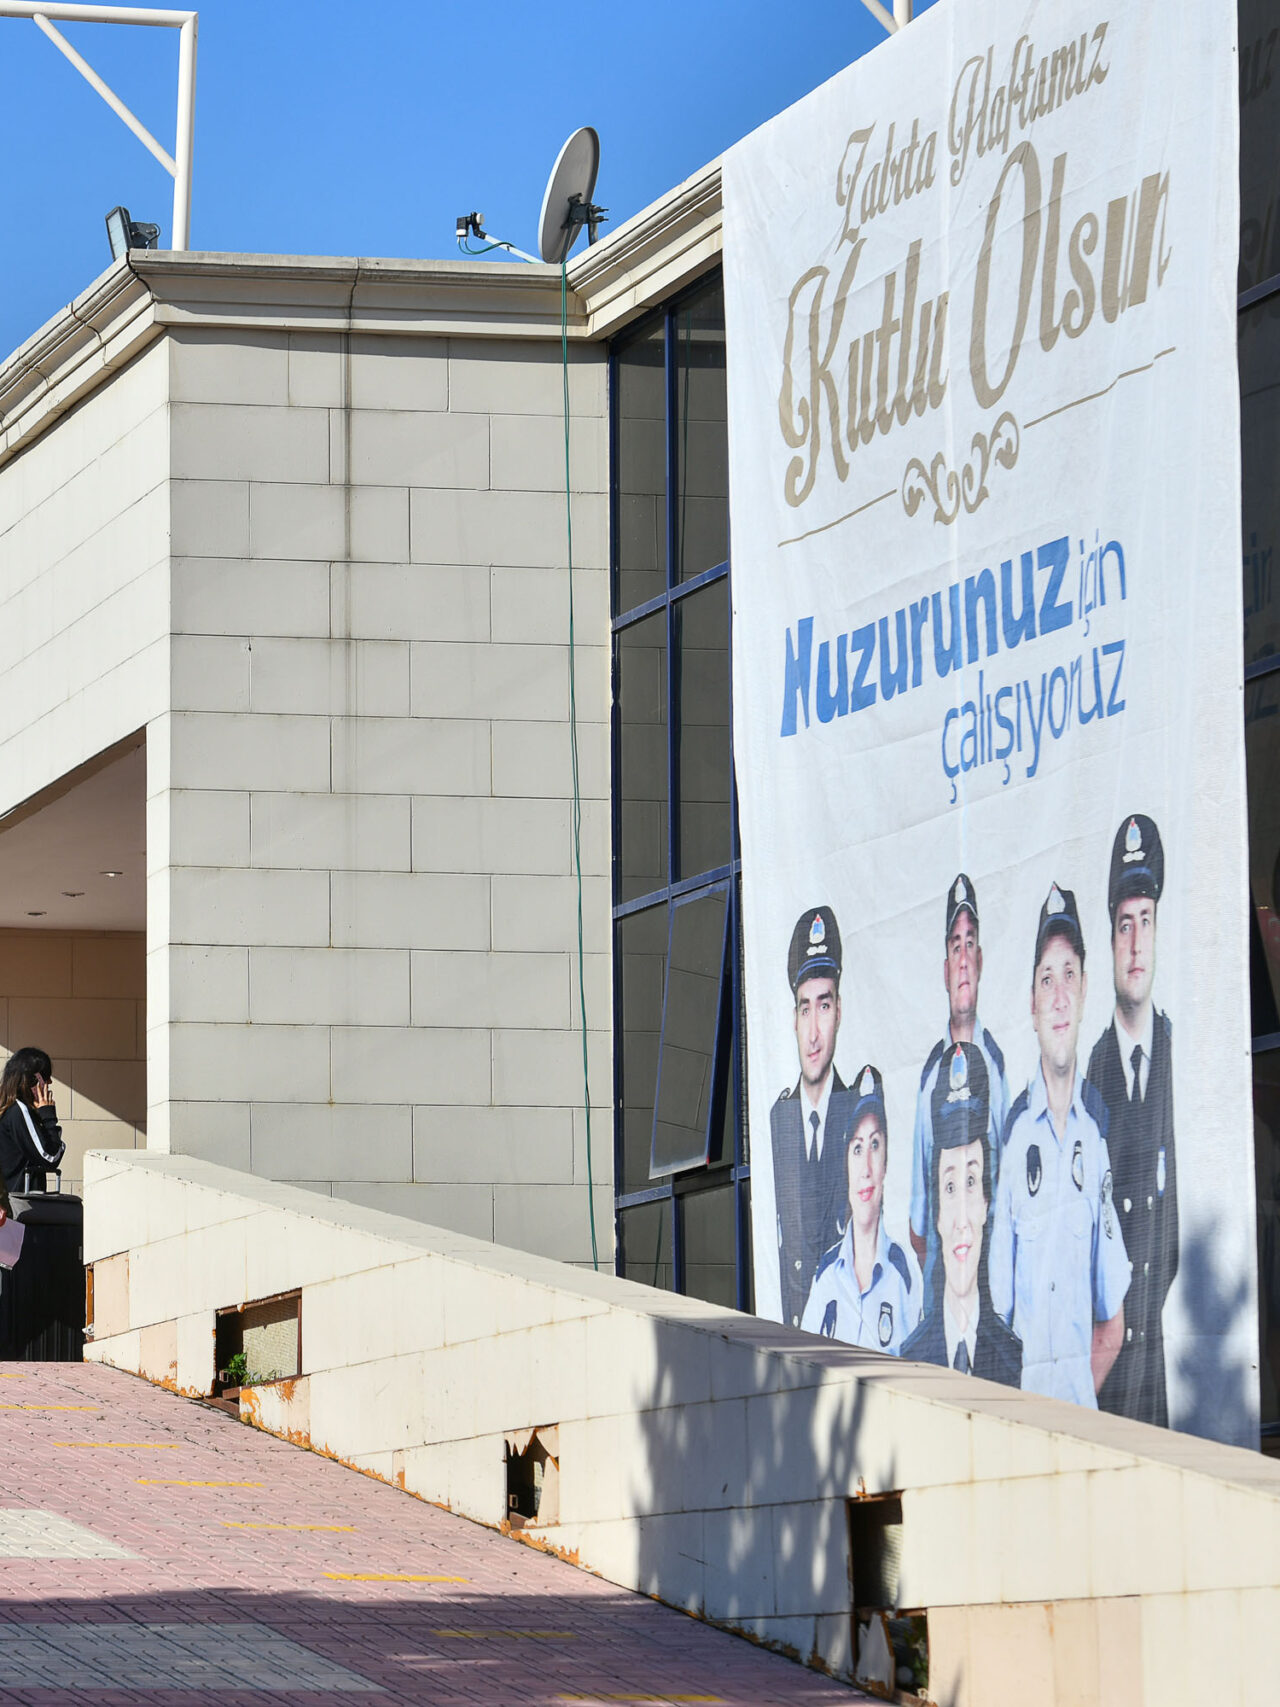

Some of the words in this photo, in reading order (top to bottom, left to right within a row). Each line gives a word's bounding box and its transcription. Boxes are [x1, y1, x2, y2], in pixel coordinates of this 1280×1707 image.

[835, 118, 938, 254] Zabıta
[948, 21, 1110, 187] Haftamız
[778, 238, 950, 507] Kutlu
[969, 140, 1172, 410] Olsun
[780, 536, 1073, 737] Huzurunuz
[1078, 528, 1127, 637] için
[942, 639, 1126, 804] çalışıyoruz
